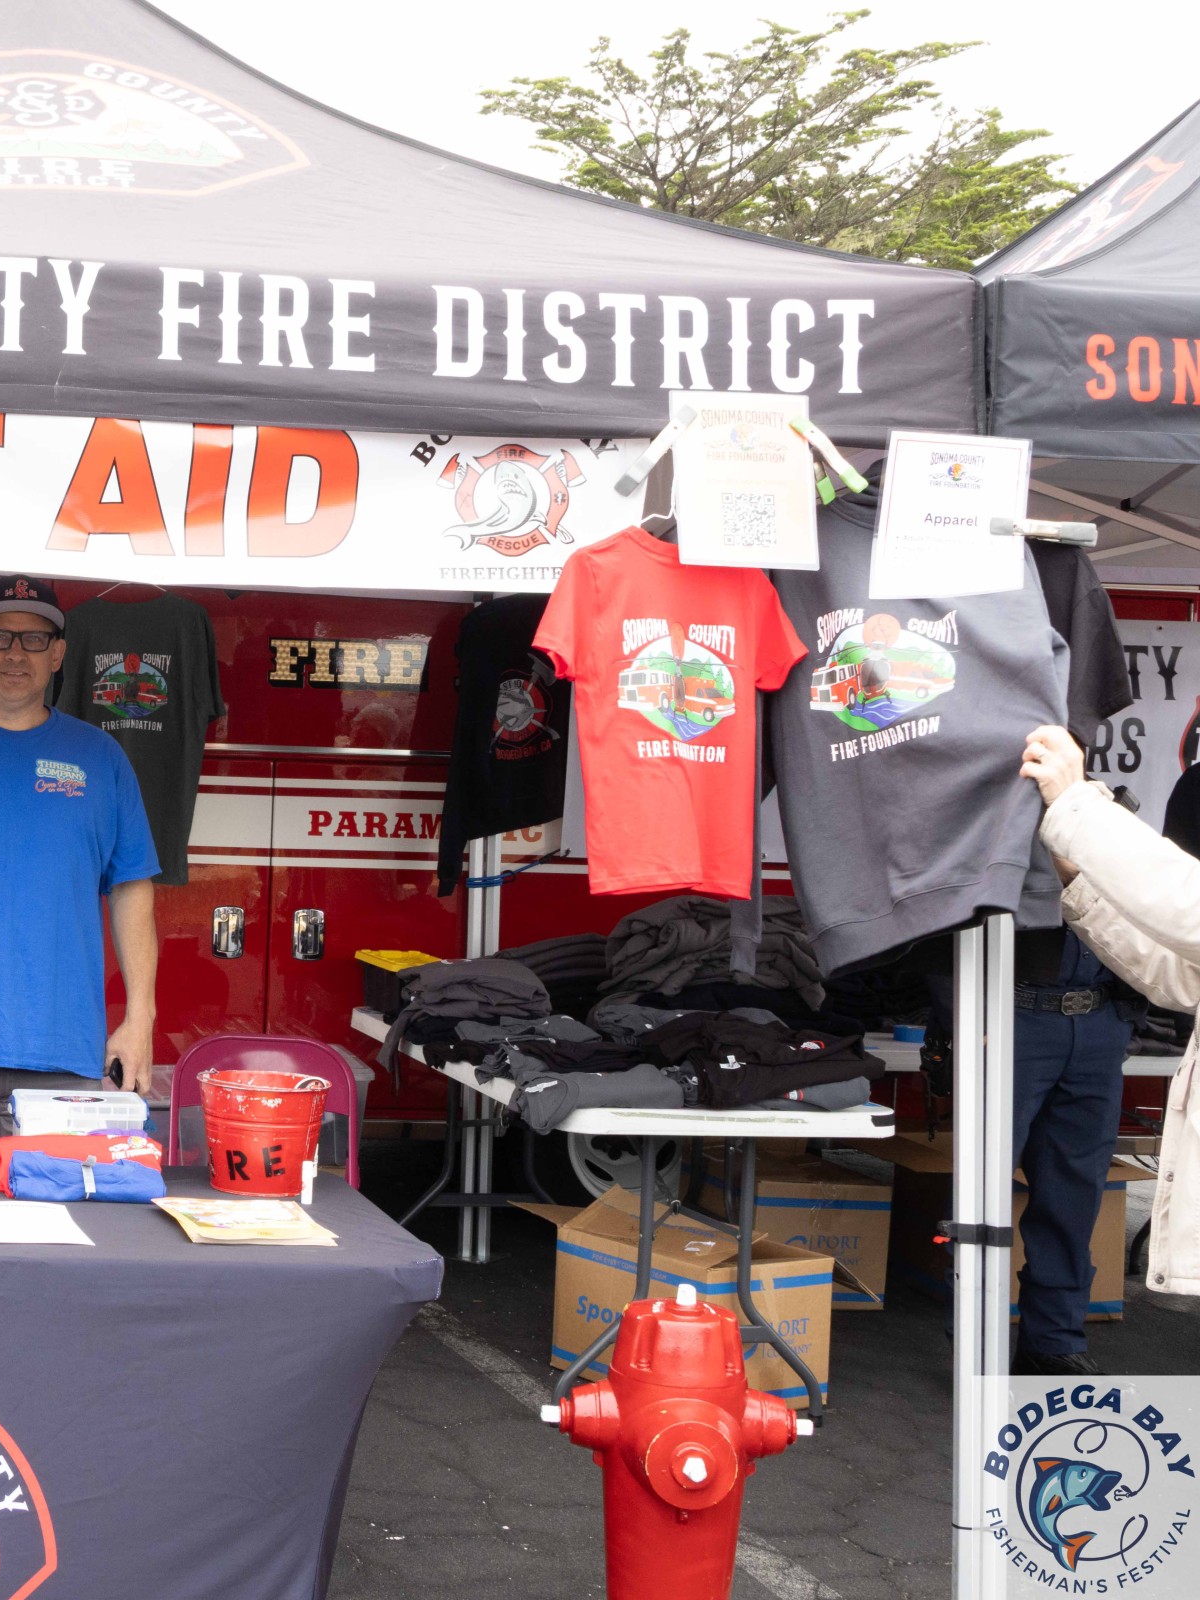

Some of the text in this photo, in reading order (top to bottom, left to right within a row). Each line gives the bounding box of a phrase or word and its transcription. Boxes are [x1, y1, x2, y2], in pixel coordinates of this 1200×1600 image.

[83, 63, 268, 143] COUNTY
[158, 265, 377, 372] FIRE
[431, 284, 875, 394] DISTRICT
[1085, 333, 1200, 405] SON
[700, 408, 784, 431] SONOMA COUNTY
[497, 449, 526, 459] FIRE
[706, 451, 786, 464] FIRE FOUNDATION
[930, 452, 985, 467] SONOMA COUNTY
[45, 418, 359, 558] AID
[924, 513, 978, 527] Apparel
[487, 534, 539, 550] RESCUE
[439, 567, 564, 580] FIREFIGHTE
[622, 618, 736, 660] SONOMA COUNTY
[816, 608, 958, 653] SONOMA COUNTY
[95, 653, 171, 674] SONOMA COUNTY
[269, 638, 425, 686] FIRE
[101, 719, 163, 731] FIRE FOUNDATION
[830, 715, 940, 762] FIRE FOUNDATION
[637, 740, 670, 758] FIRE
[814, 1235, 860, 1249] PORT
[770, 1317, 810, 1337] ORT
